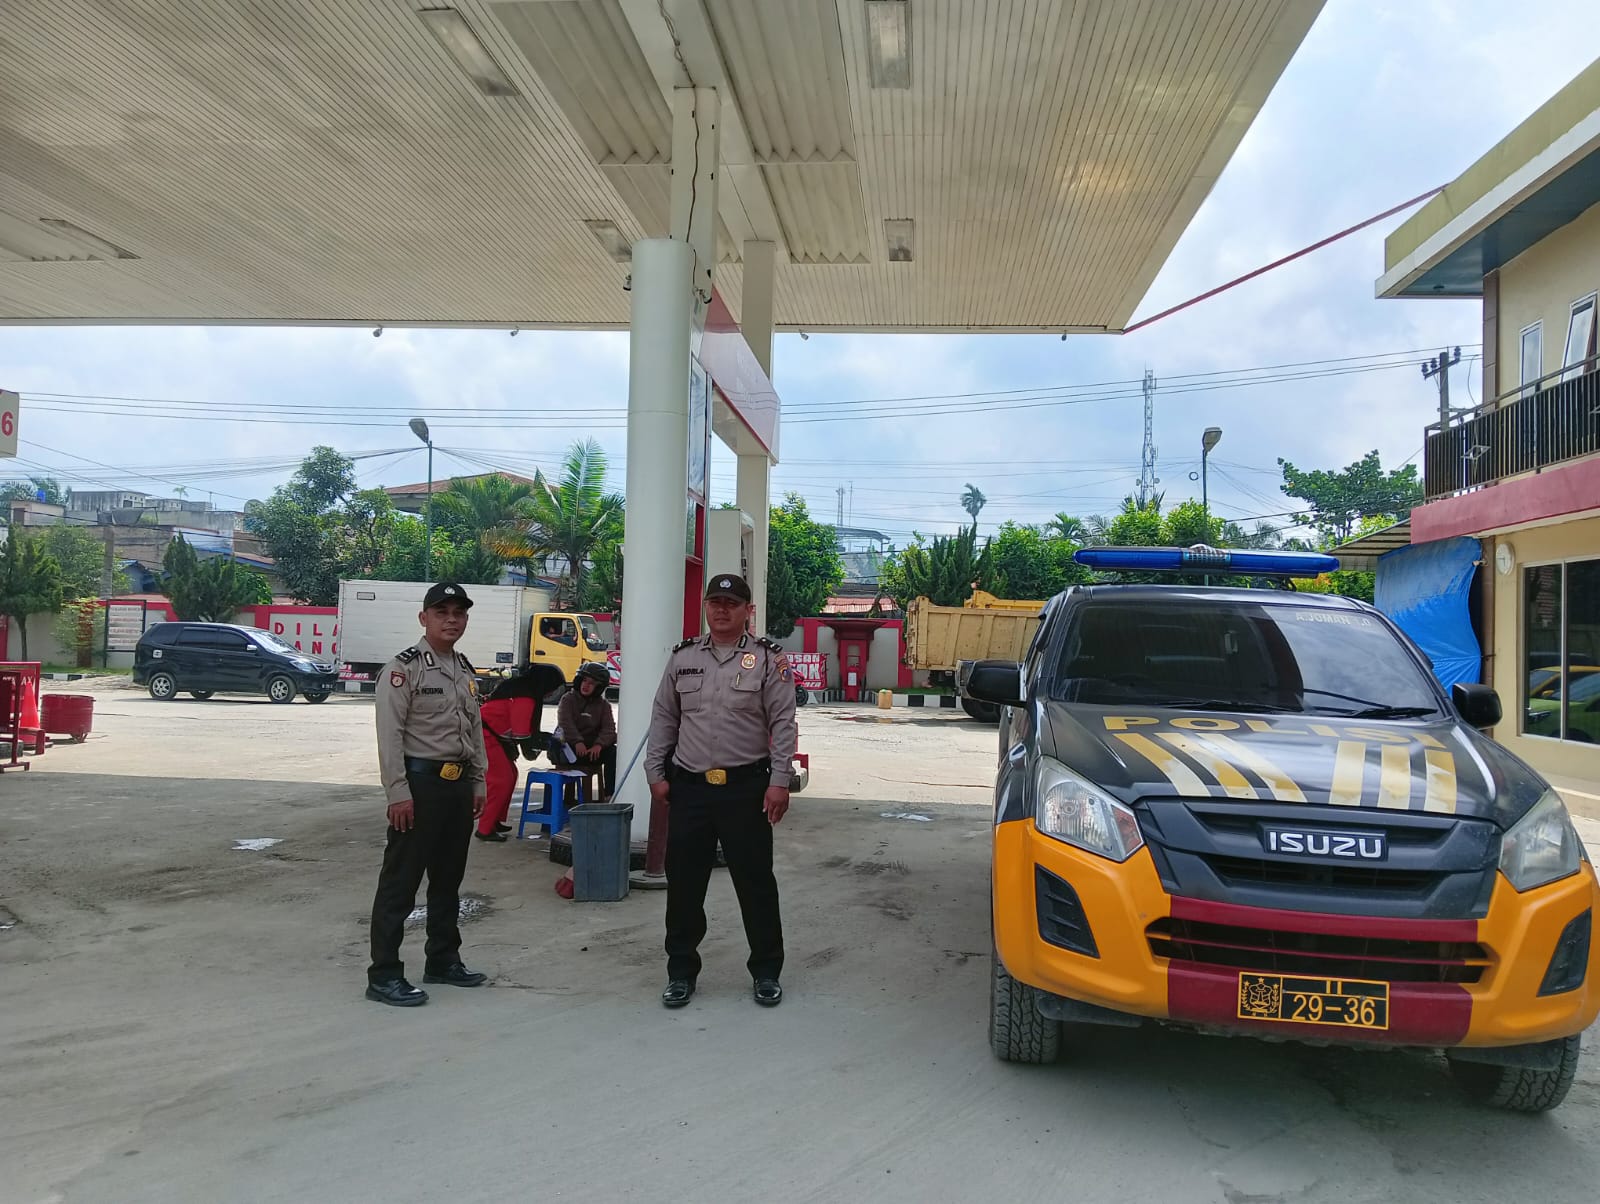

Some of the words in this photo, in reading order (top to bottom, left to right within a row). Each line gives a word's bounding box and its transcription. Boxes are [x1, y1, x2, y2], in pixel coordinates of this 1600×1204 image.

[1, 410, 14, 437] 6
[1102, 715, 1448, 749] POLISI
[1268, 830, 1383, 860] ISUZU
[1291, 993, 1377, 1027] 29-36
